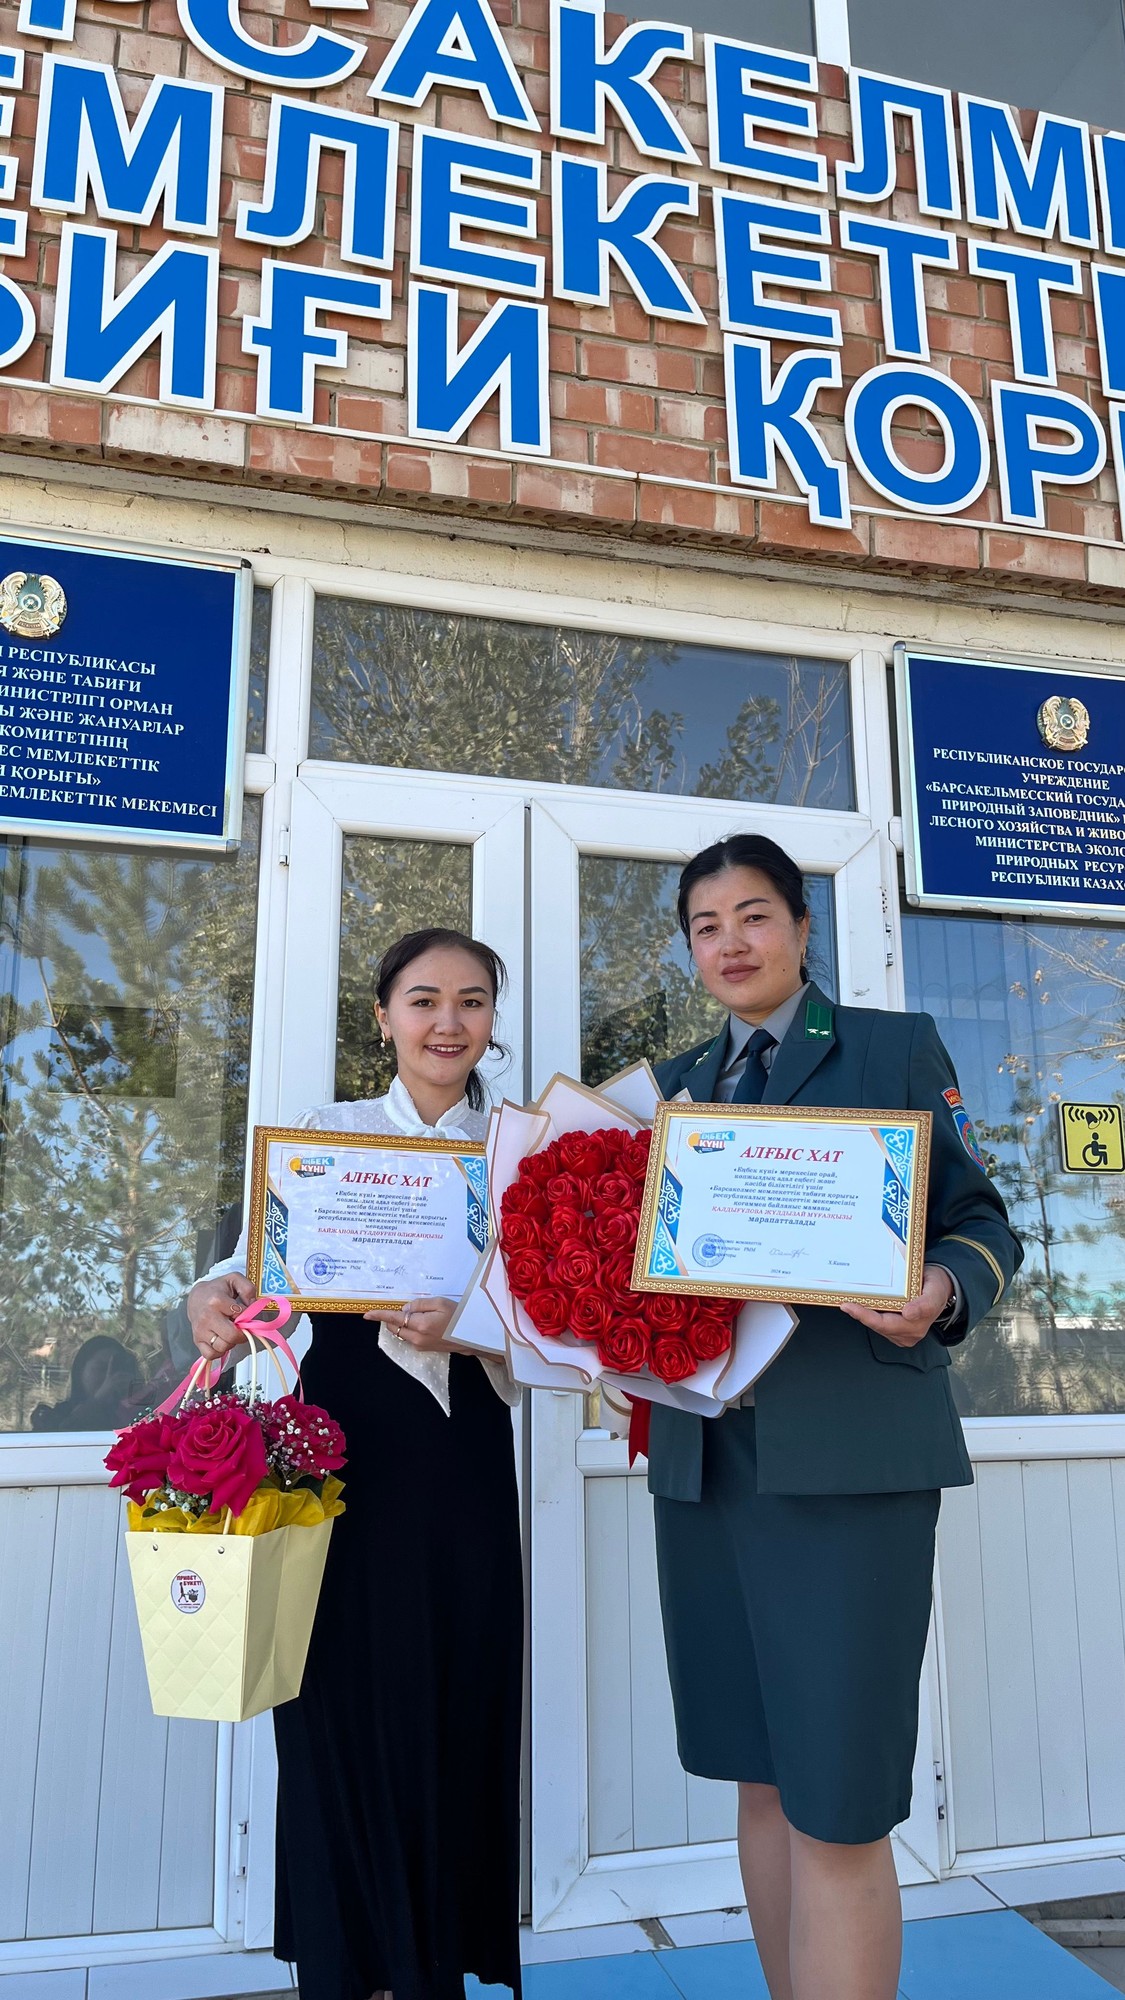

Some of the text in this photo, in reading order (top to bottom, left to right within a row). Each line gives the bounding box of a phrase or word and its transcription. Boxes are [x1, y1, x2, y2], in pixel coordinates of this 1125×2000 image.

[722, 331, 1125, 540] ҚОР
[8, 646, 156, 676] РЕСПУБЛИКАСЫ
[12, 666, 67, 684] ЖӘНЕ
[72, 674, 142, 693] ТАБИҒИ
[110, 698, 173, 716] ОРМАН
[19, 706, 74, 724] ЖӘНЕ
[78, 713, 185, 736] ЖАНУАРЛАР
[0, 725, 129, 751] КОМИТЕТІНІҢ
[26, 747, 160, 772] МЕМЛЕКЕТТІК
[933, 748, 1125, 776] РЕСПУБЛИКАНСКОЕ ГОСУДАР
[10, 766, 102, 786] ҚОРЫҒЫ»
[1021, 772, 1110, 791] УЧРЕЖДЕНИЕ
[0, 785, 217, 818] ЕМЛЕКЕТТІК МЕКЕМЕСІ
[925, 782, 1073, 804] «БАРСАКЕЛЬМЕССКИЙ
[941, 799, 1026, 816] ПРИРОДНЫЙ
[1028, 806, 1121, 824] ЗАПОВЕДНИК»
[929, 815, 995, 830] ЛЕСНОГО
[996, 820, 1073, 837] ХОЗЯЙСТВА
[1075, 826, 1086, 838] И
[975, 836, 1083, 854] МИНИСТЕРСТВА
[996, 854, 1125, 874] ПРИРОДНЫХ РЕСУР
[991, 871, 1125, 891] РЕСПУБЛИКИ КАЗАХ
[740, 1146, 843, 1163] АЛҒЫС ХАТ
[341, 1171, 432, 1188] АЛҒЫС ХАТ
